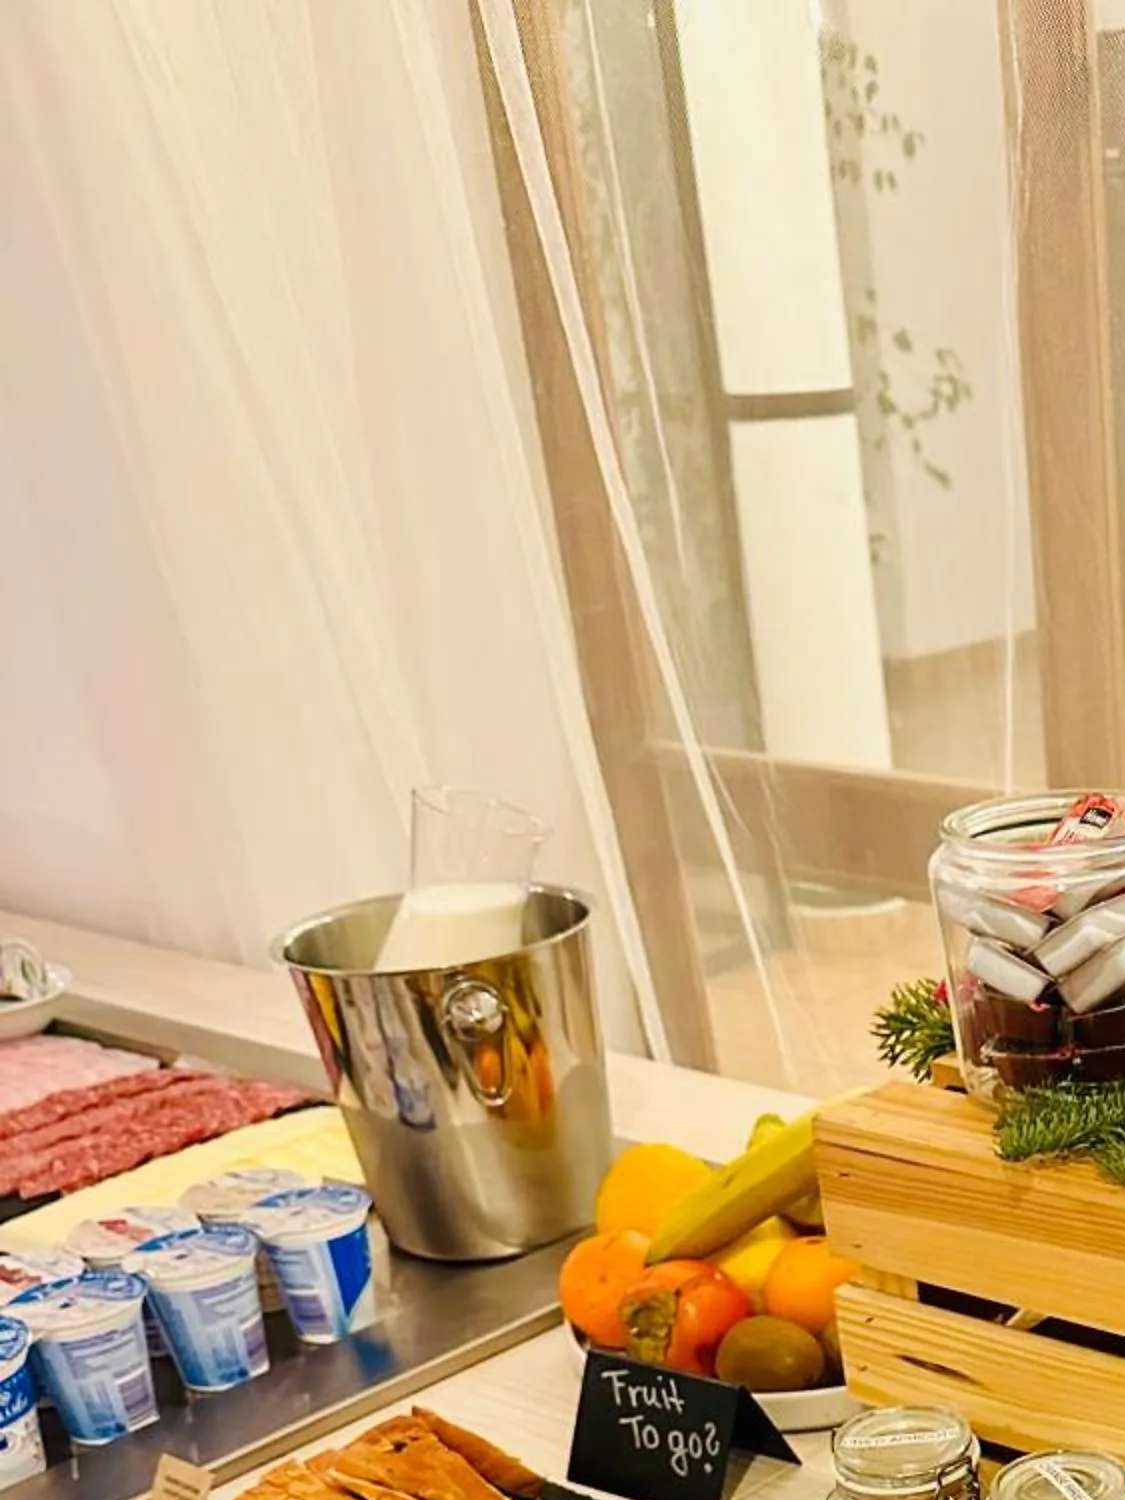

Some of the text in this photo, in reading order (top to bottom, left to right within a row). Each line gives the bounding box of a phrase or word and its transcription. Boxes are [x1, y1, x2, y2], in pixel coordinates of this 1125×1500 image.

[601, 1368, 686, 1414] Fruit
[618, 1414, 721, 1478] To go?
